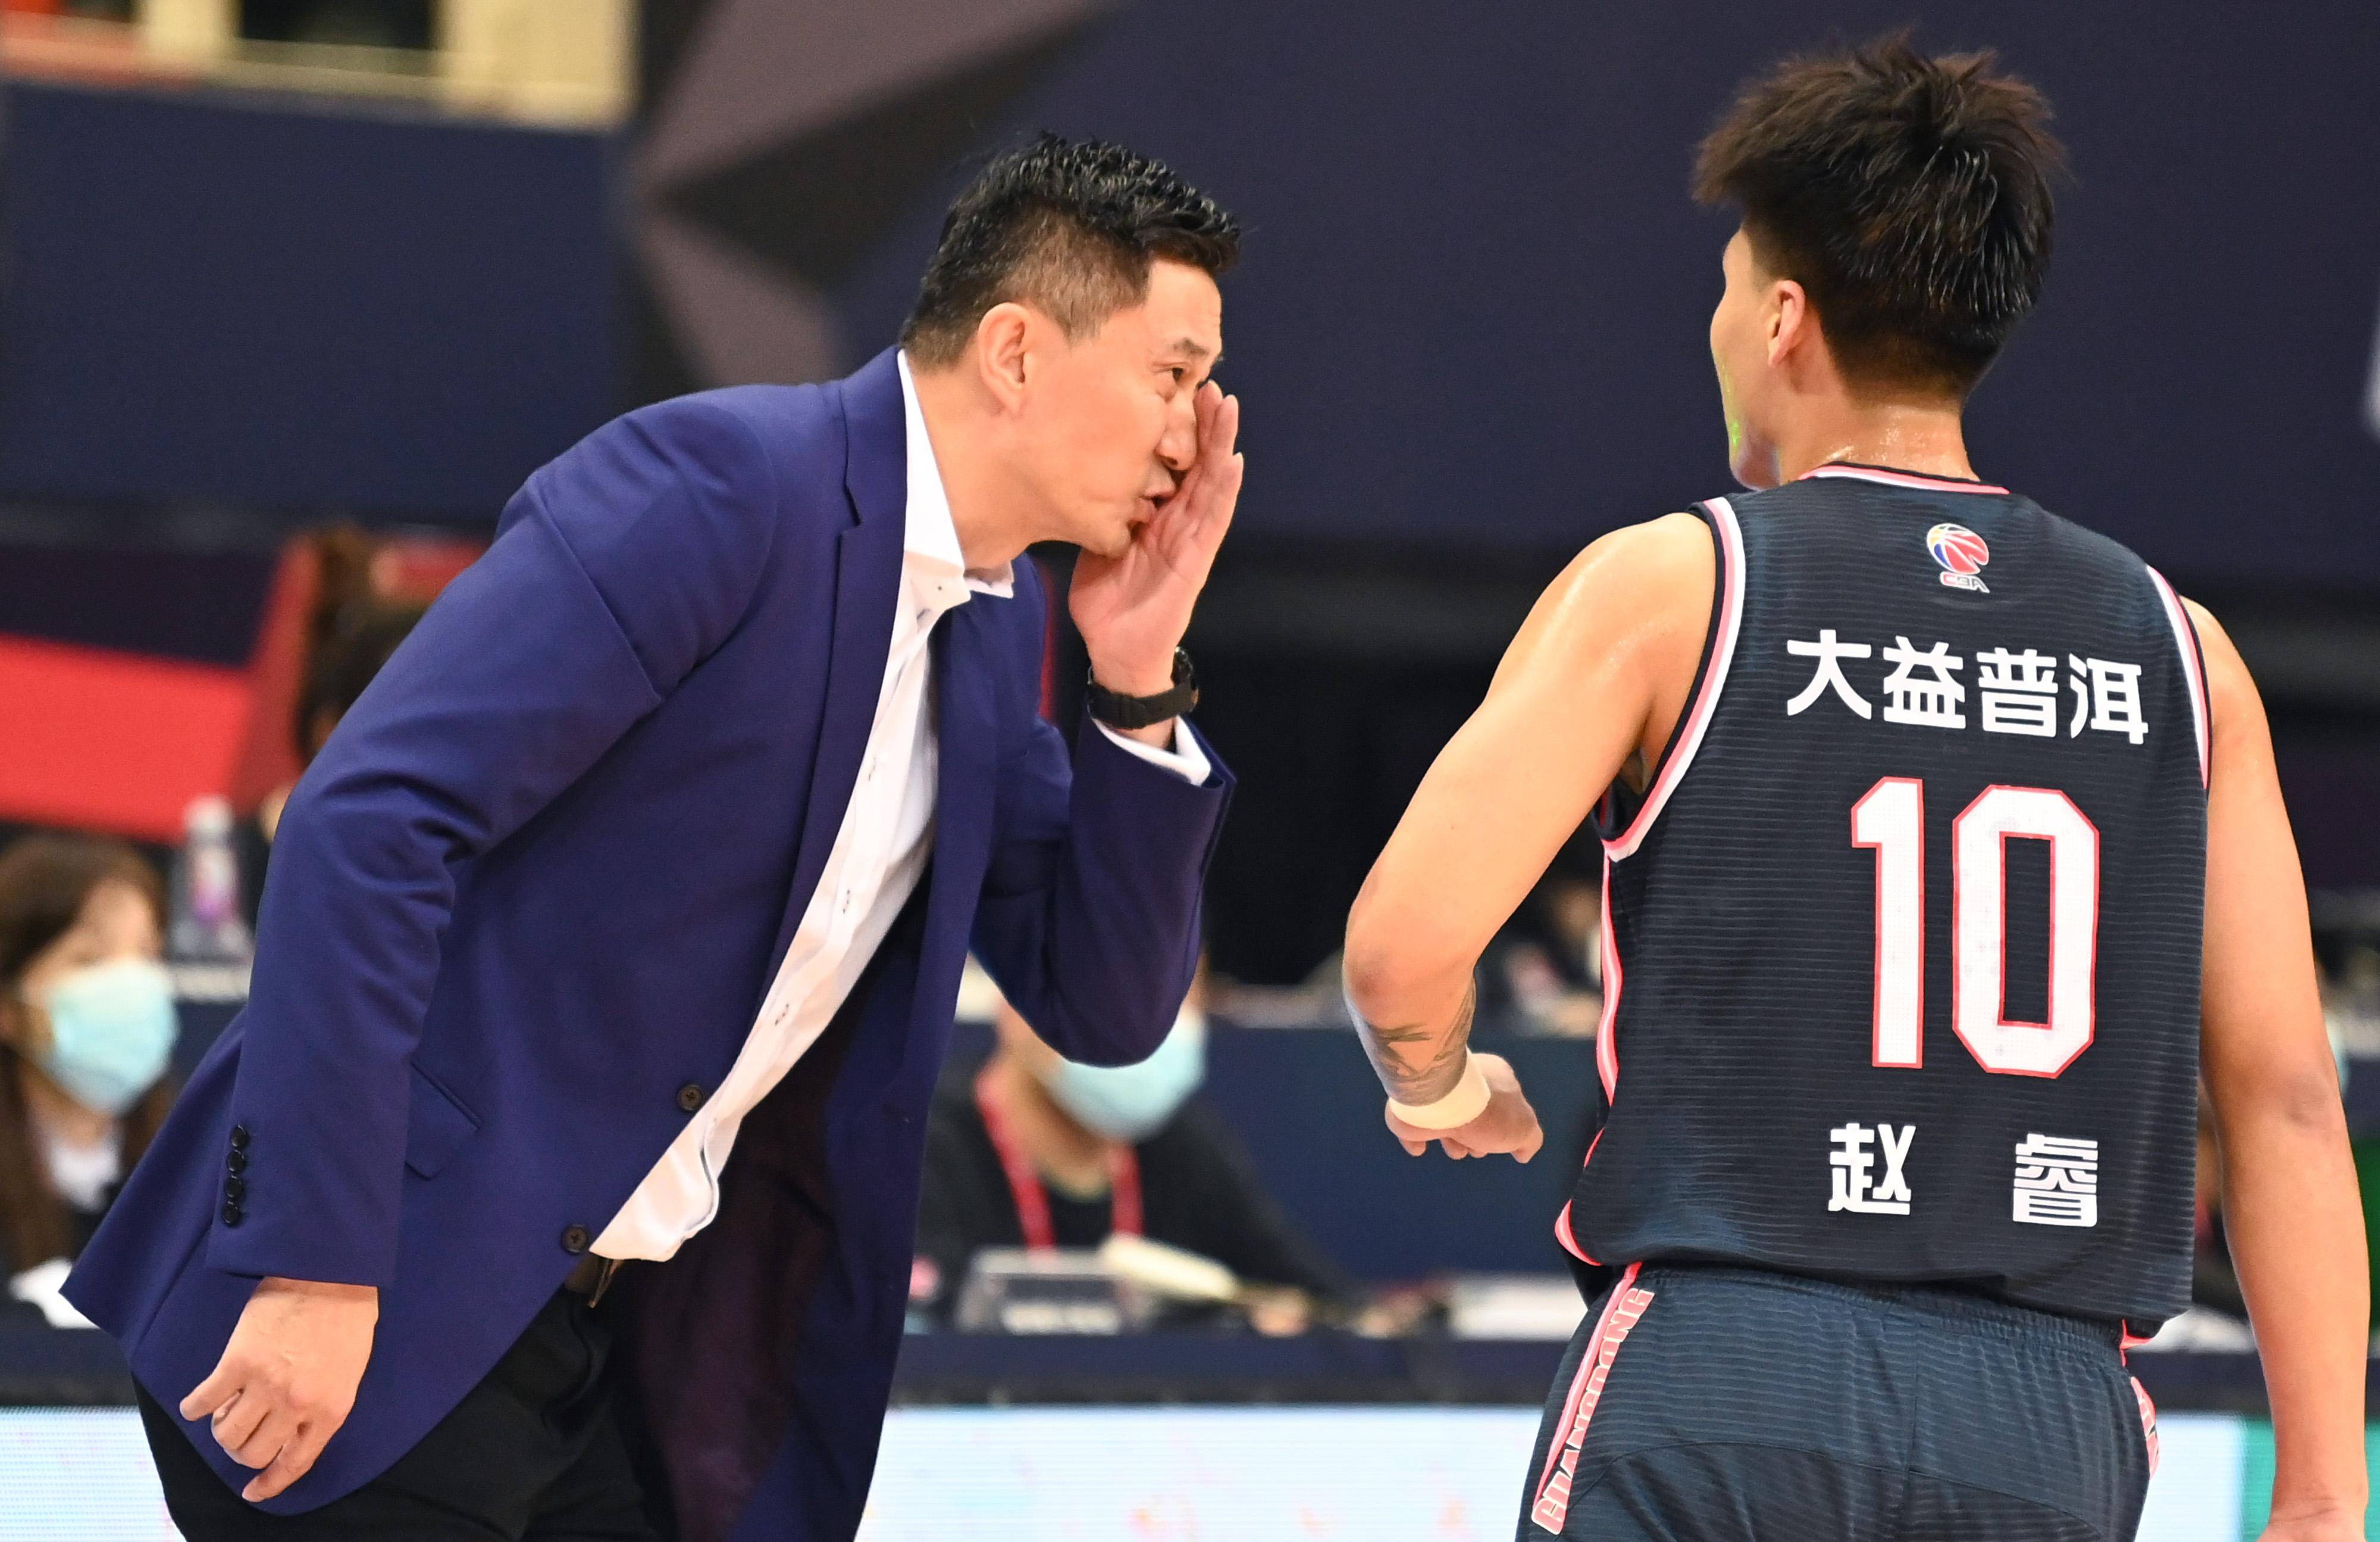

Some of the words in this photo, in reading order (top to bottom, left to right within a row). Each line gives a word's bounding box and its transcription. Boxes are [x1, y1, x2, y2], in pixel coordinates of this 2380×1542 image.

[1940, 571, 1990, 593] CBA
[1786, 629, 2149, 744] 大益普洱
[1850, 776, 2099, 1078] 10
